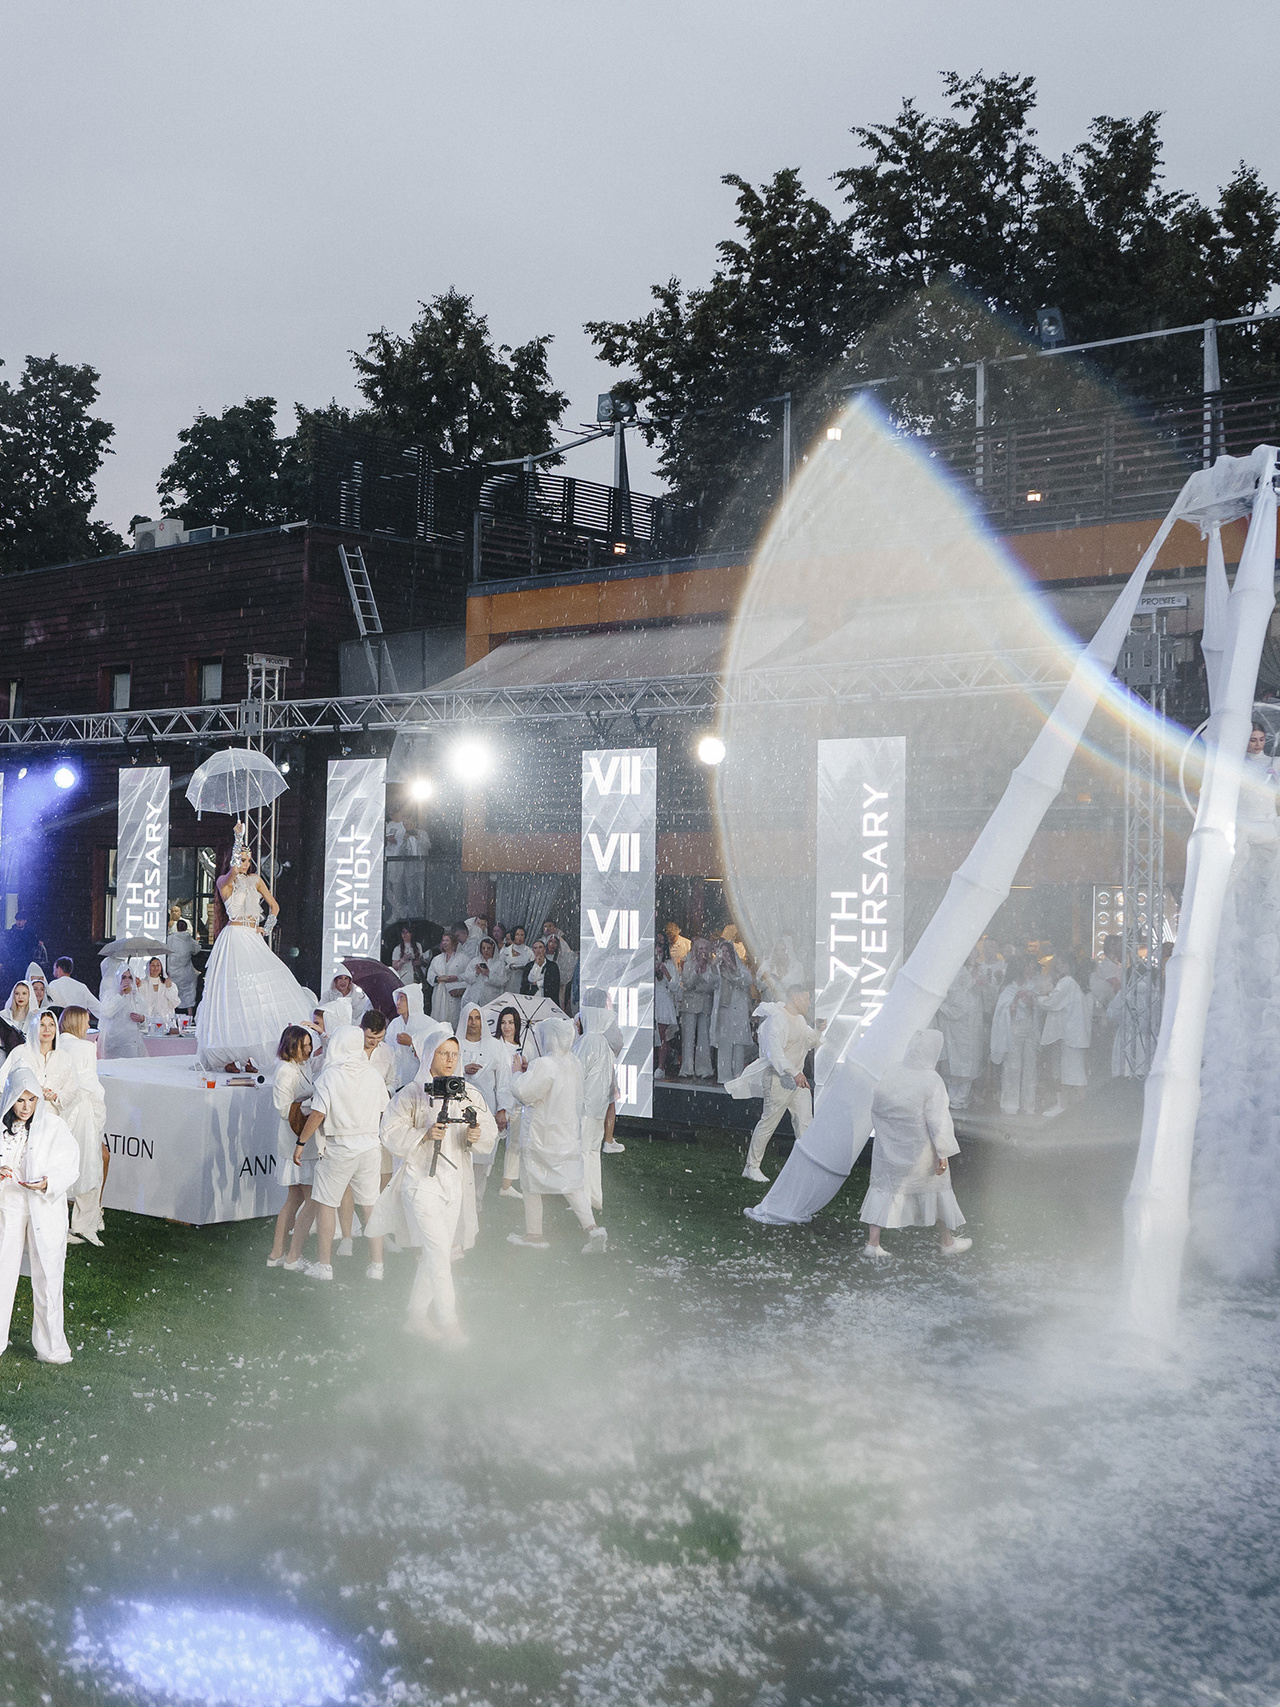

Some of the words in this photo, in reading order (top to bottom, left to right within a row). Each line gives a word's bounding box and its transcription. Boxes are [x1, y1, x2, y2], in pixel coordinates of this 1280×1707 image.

[1141, 597, 1176, 605] PROLYTE
[589, 756, 641, 795] VII
[588, 832, 640, 872] VII
[125, 882, 144, 939] TH
[333, 824, 355, 973] ITEWILL
[351, 836, 372, 958] SATION
[860, 783, 889, 1039] NIVERSARY
[587, 909, 639, 949] VII
[829, 891, 859, 982] 7TH
[613, 1064, 637, 1105] II
